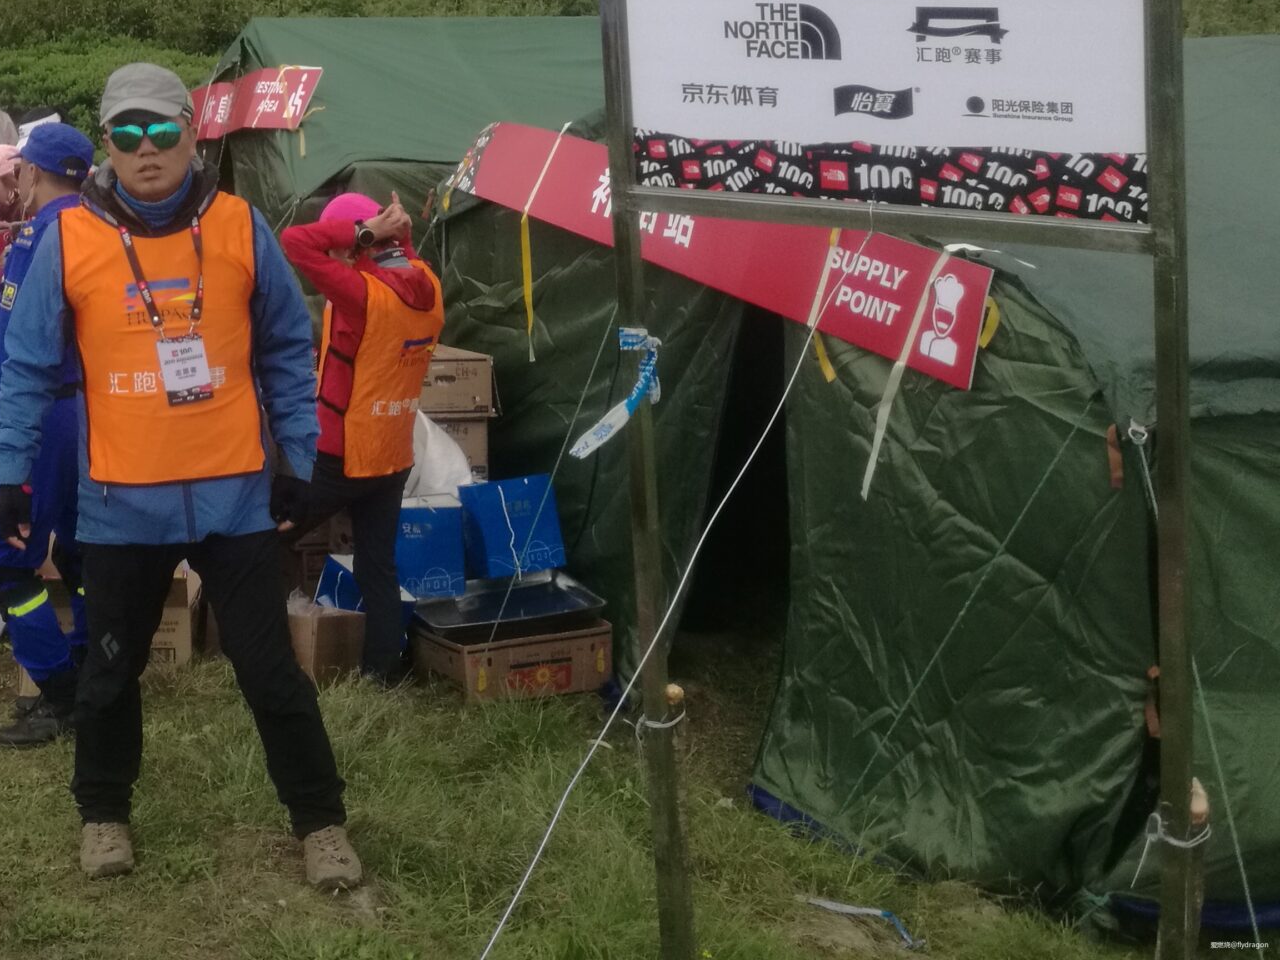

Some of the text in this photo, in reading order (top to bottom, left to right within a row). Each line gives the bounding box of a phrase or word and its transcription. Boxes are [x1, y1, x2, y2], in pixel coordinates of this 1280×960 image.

[755, 2, 799, 21] THE
[724, 21, 799, 40] NORTH
[746, 40, 800, 59] FACE
[681, 83, 779, 108] 京东体育
[992, 99, 1073, 115] 阳光保险集团
[854, 163, 913, 190] 100
[830, 247, 908, 290] SUPPLY
[835, 285, 901, 325] POINT
